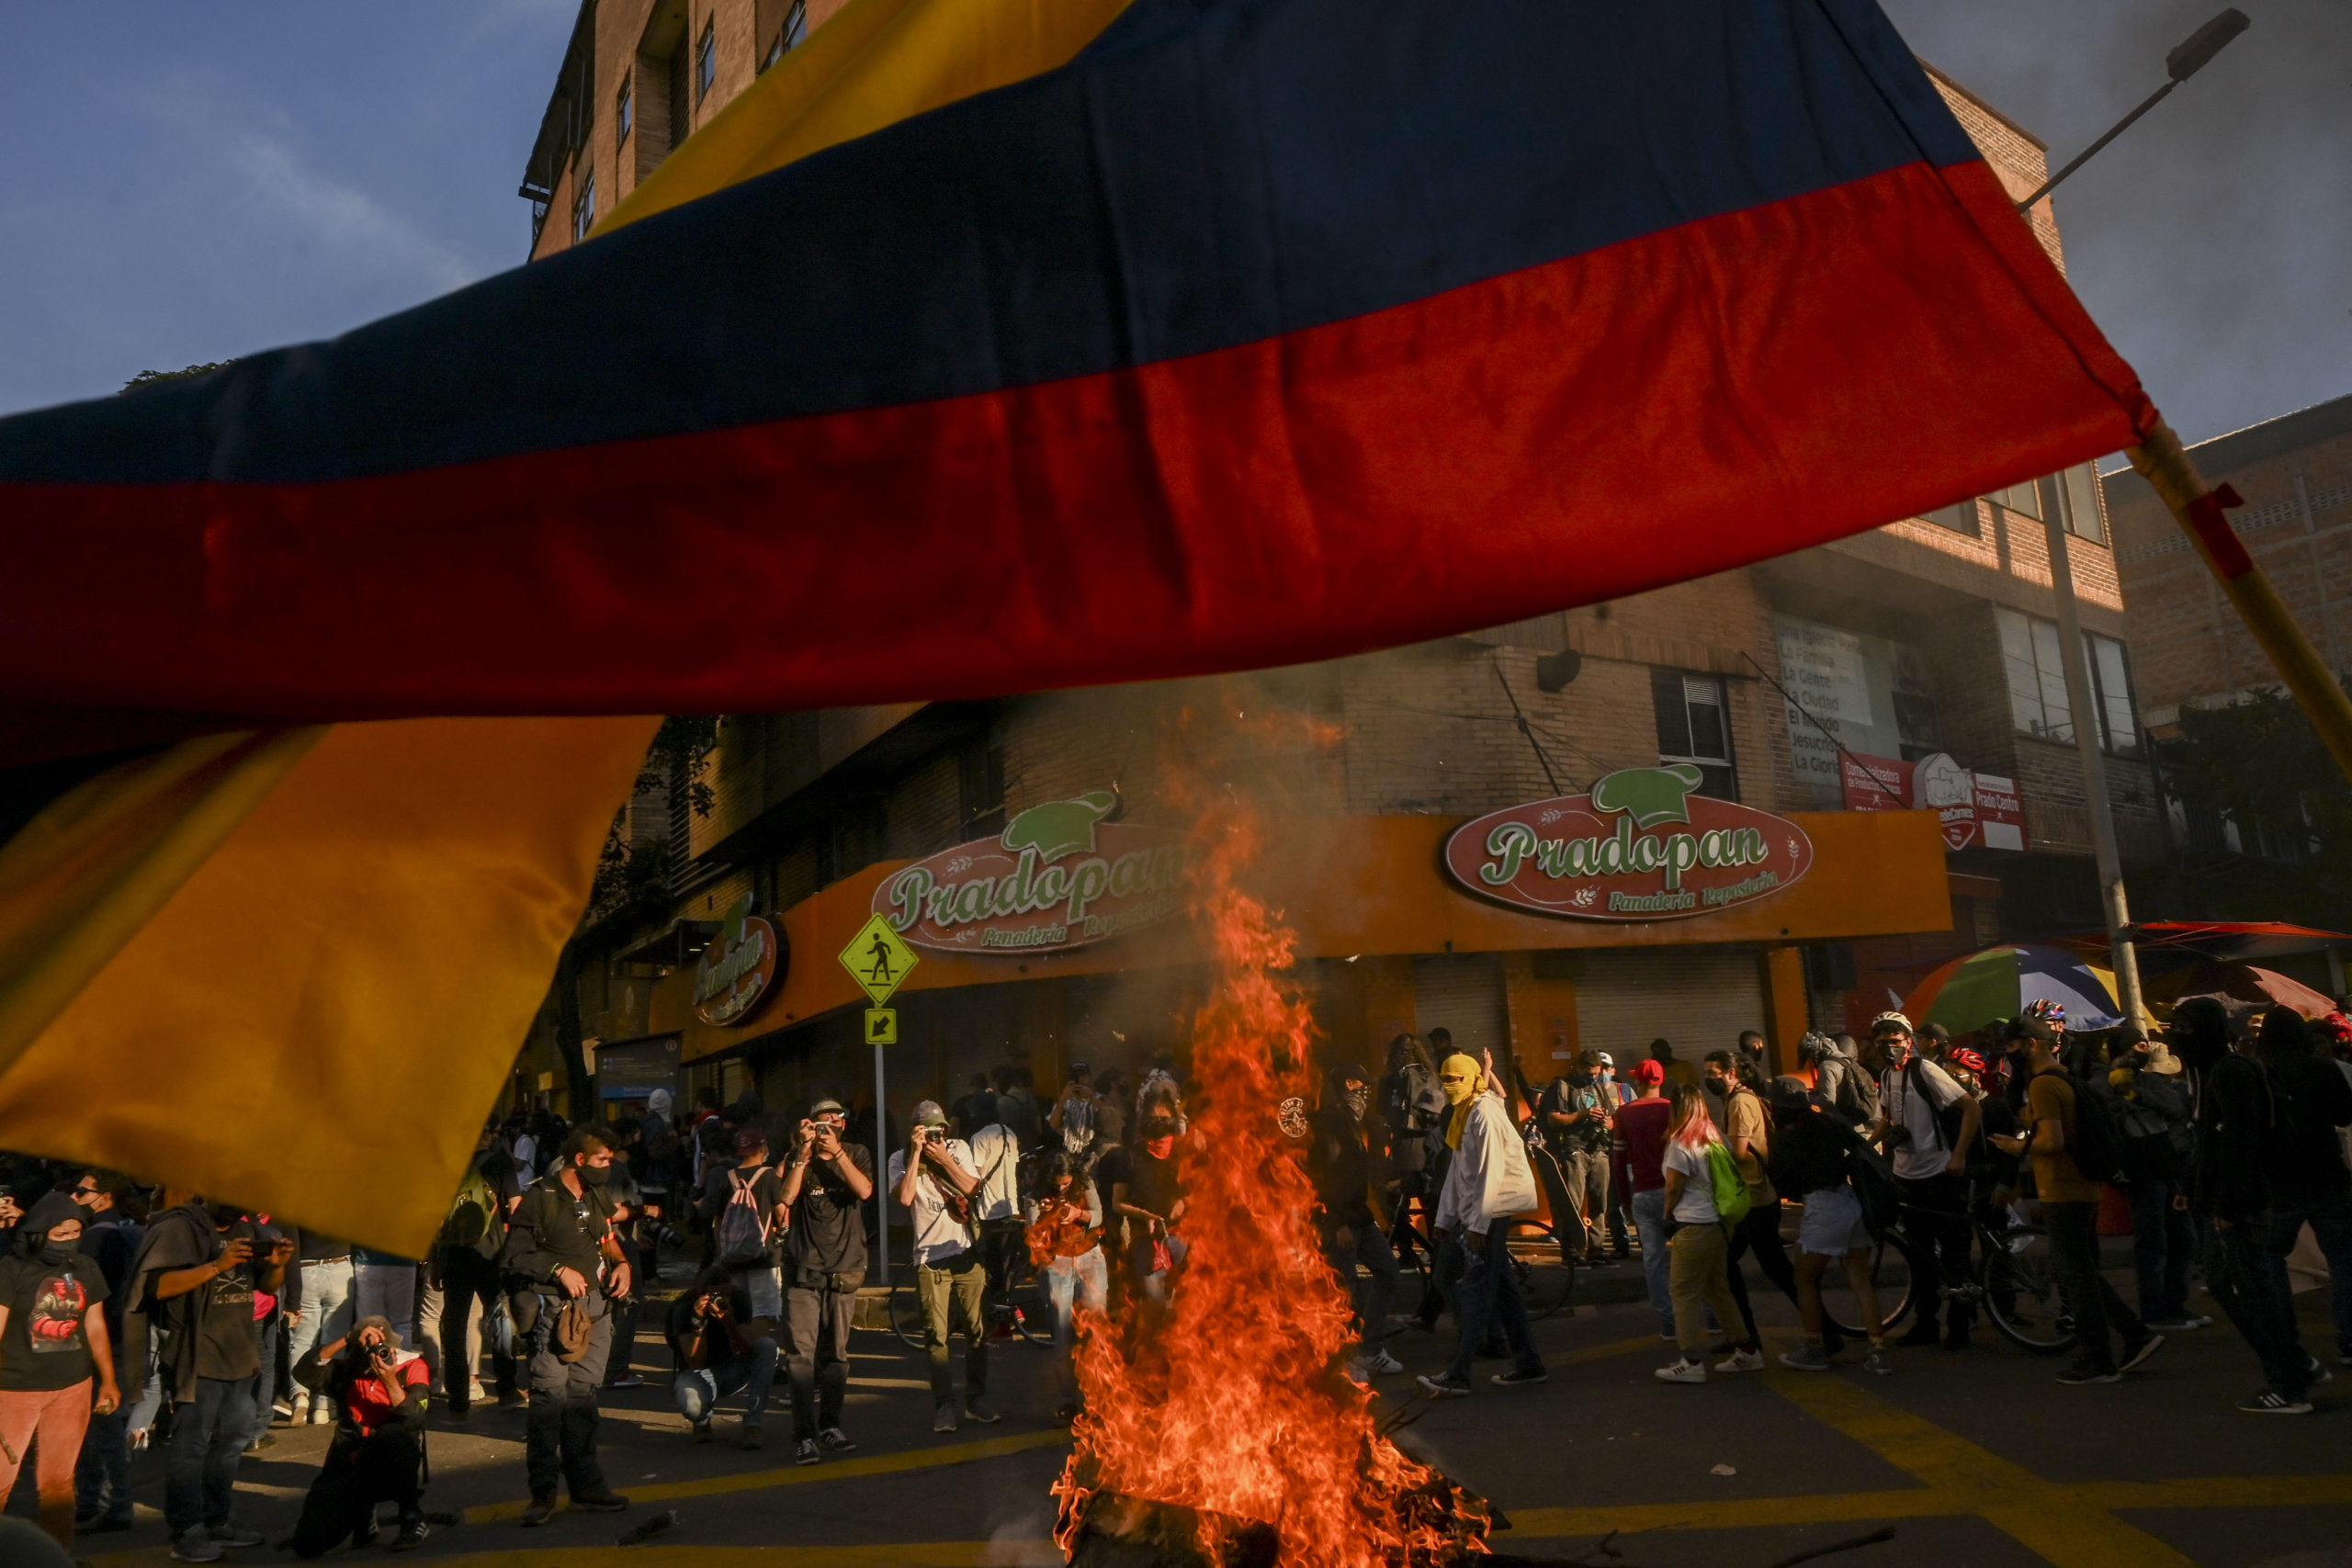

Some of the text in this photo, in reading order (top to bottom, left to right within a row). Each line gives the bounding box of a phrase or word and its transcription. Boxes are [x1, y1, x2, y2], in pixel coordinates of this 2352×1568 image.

[1781, 645, 1835, 669] La Familia
[1782, 666, 1831, 689] La Gente
[1802, 691, 1839, 711] Ciudad
[1789, 708, 1839, 733] El Mundo
[1794, 754, 1807, 770] La
[1975, 790, 2020, 813] Prado Centro
[1479, 815, 1769, 890] Pradopan
[888, 847, 1192, 932] Pradopan
[1608, 871, 1779, 912] Panaderia Reposteria
[980, 922, 1068, 947] Panaderia
